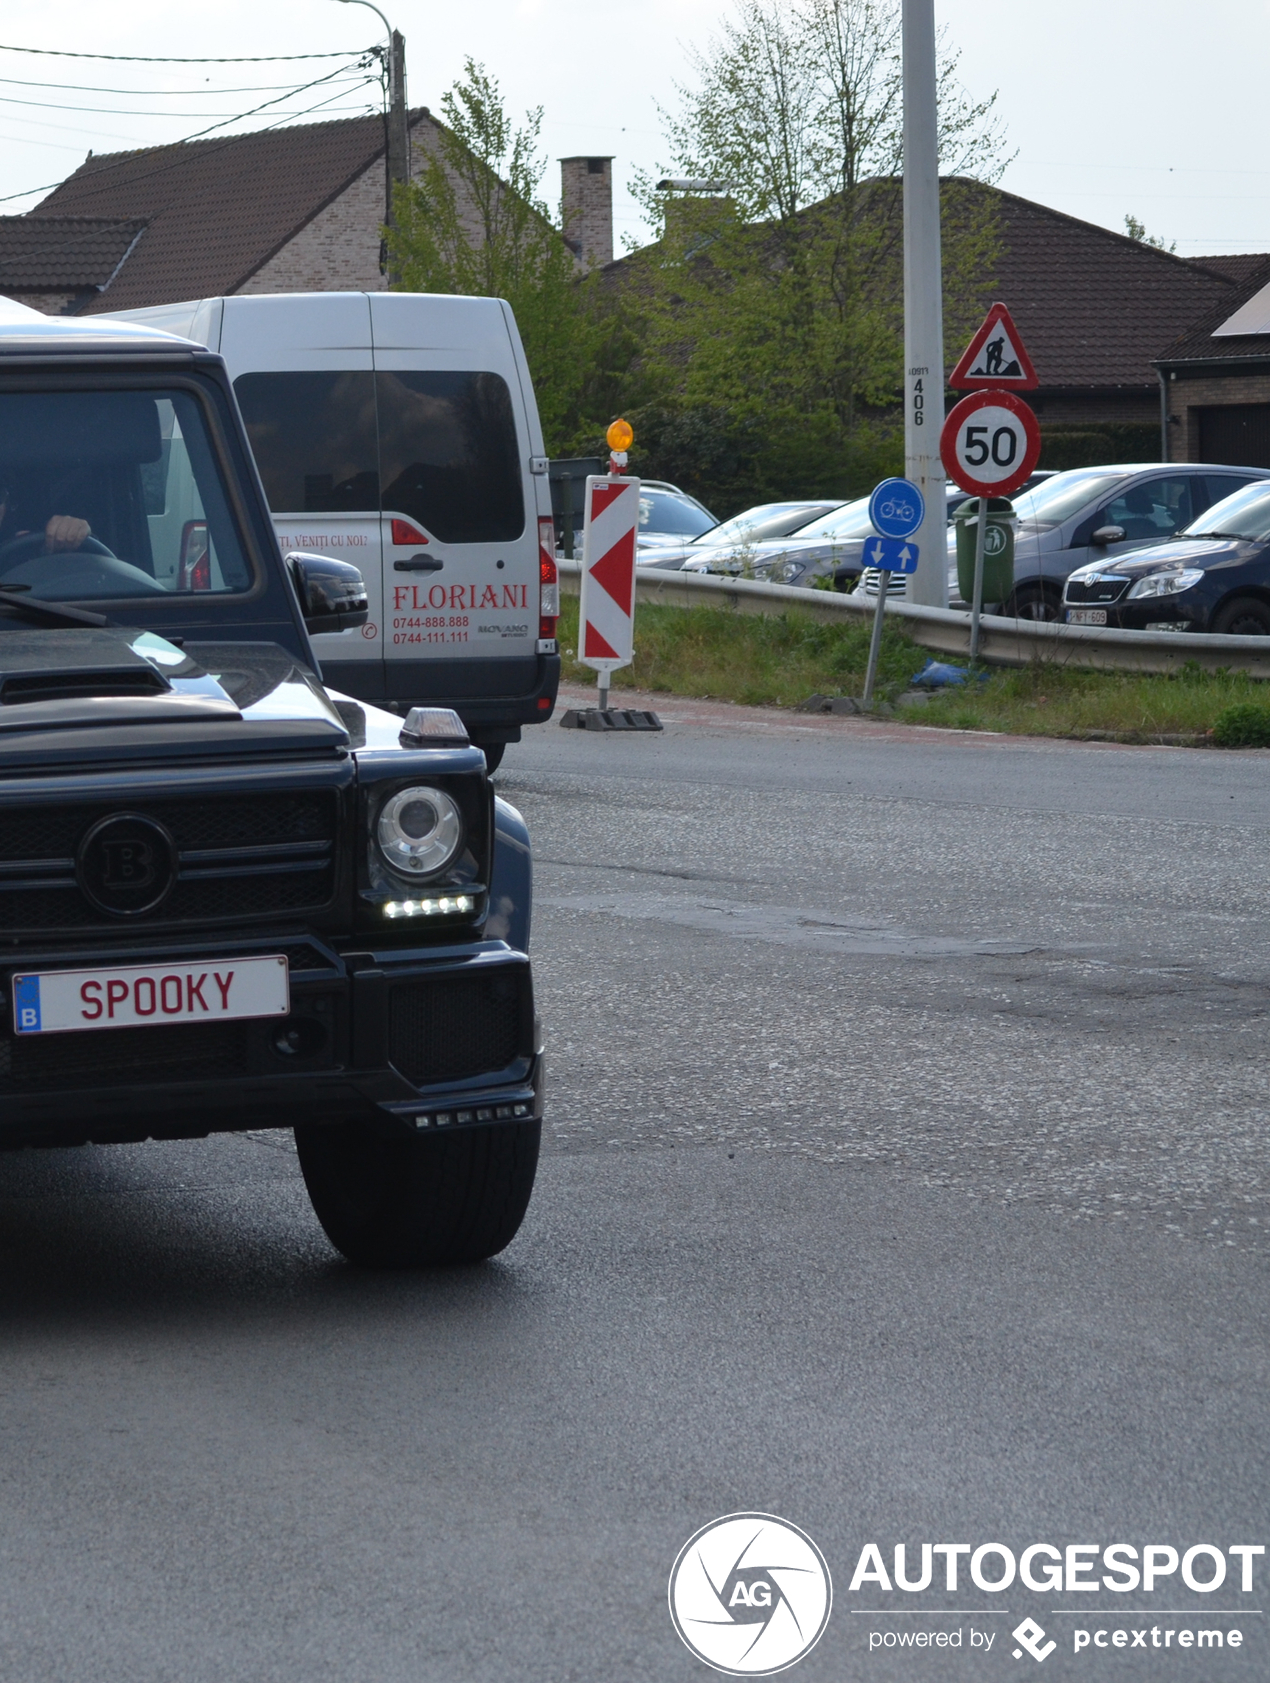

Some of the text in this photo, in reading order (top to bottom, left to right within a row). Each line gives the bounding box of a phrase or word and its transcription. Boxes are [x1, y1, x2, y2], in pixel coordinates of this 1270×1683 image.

[914, 378, 924, 427] 406
[964, 426, 1017, 468] 50
[330, 535, 344, 547] CU
[346, 535, 368, 547] NOI?
[393, 584, 529, 611] FLORIANI
[393, 615, 470, 629] 0744-888.888
[478, 624, 529, 634] MOVANO
[393, 631, 469, 645] 0744-111.111
[80, 971, 235, 1020] SPOOKY
[21, 1007, 38, 1027] B
